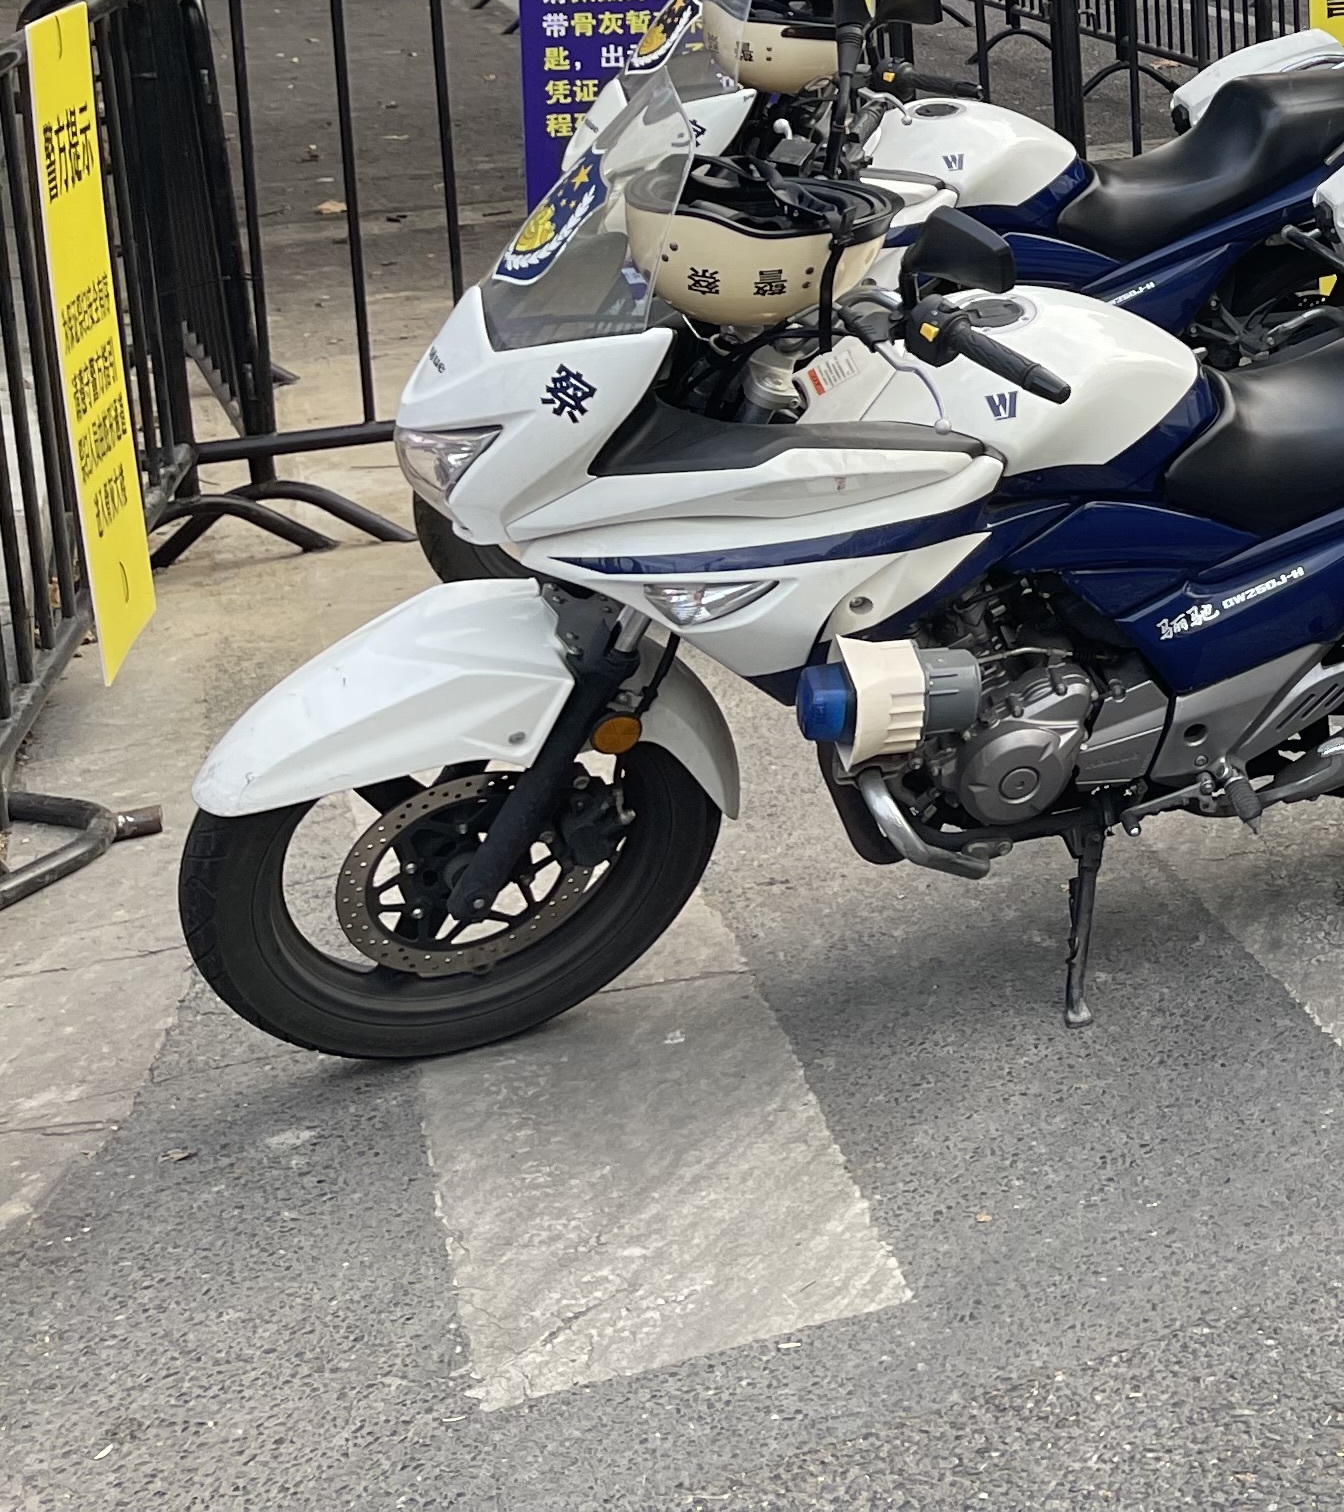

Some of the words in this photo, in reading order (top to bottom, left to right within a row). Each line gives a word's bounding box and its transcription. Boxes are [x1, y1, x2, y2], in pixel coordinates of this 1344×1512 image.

[43, 101, 94, 204] 警方提示
[540, 363, 598, 423] 察
